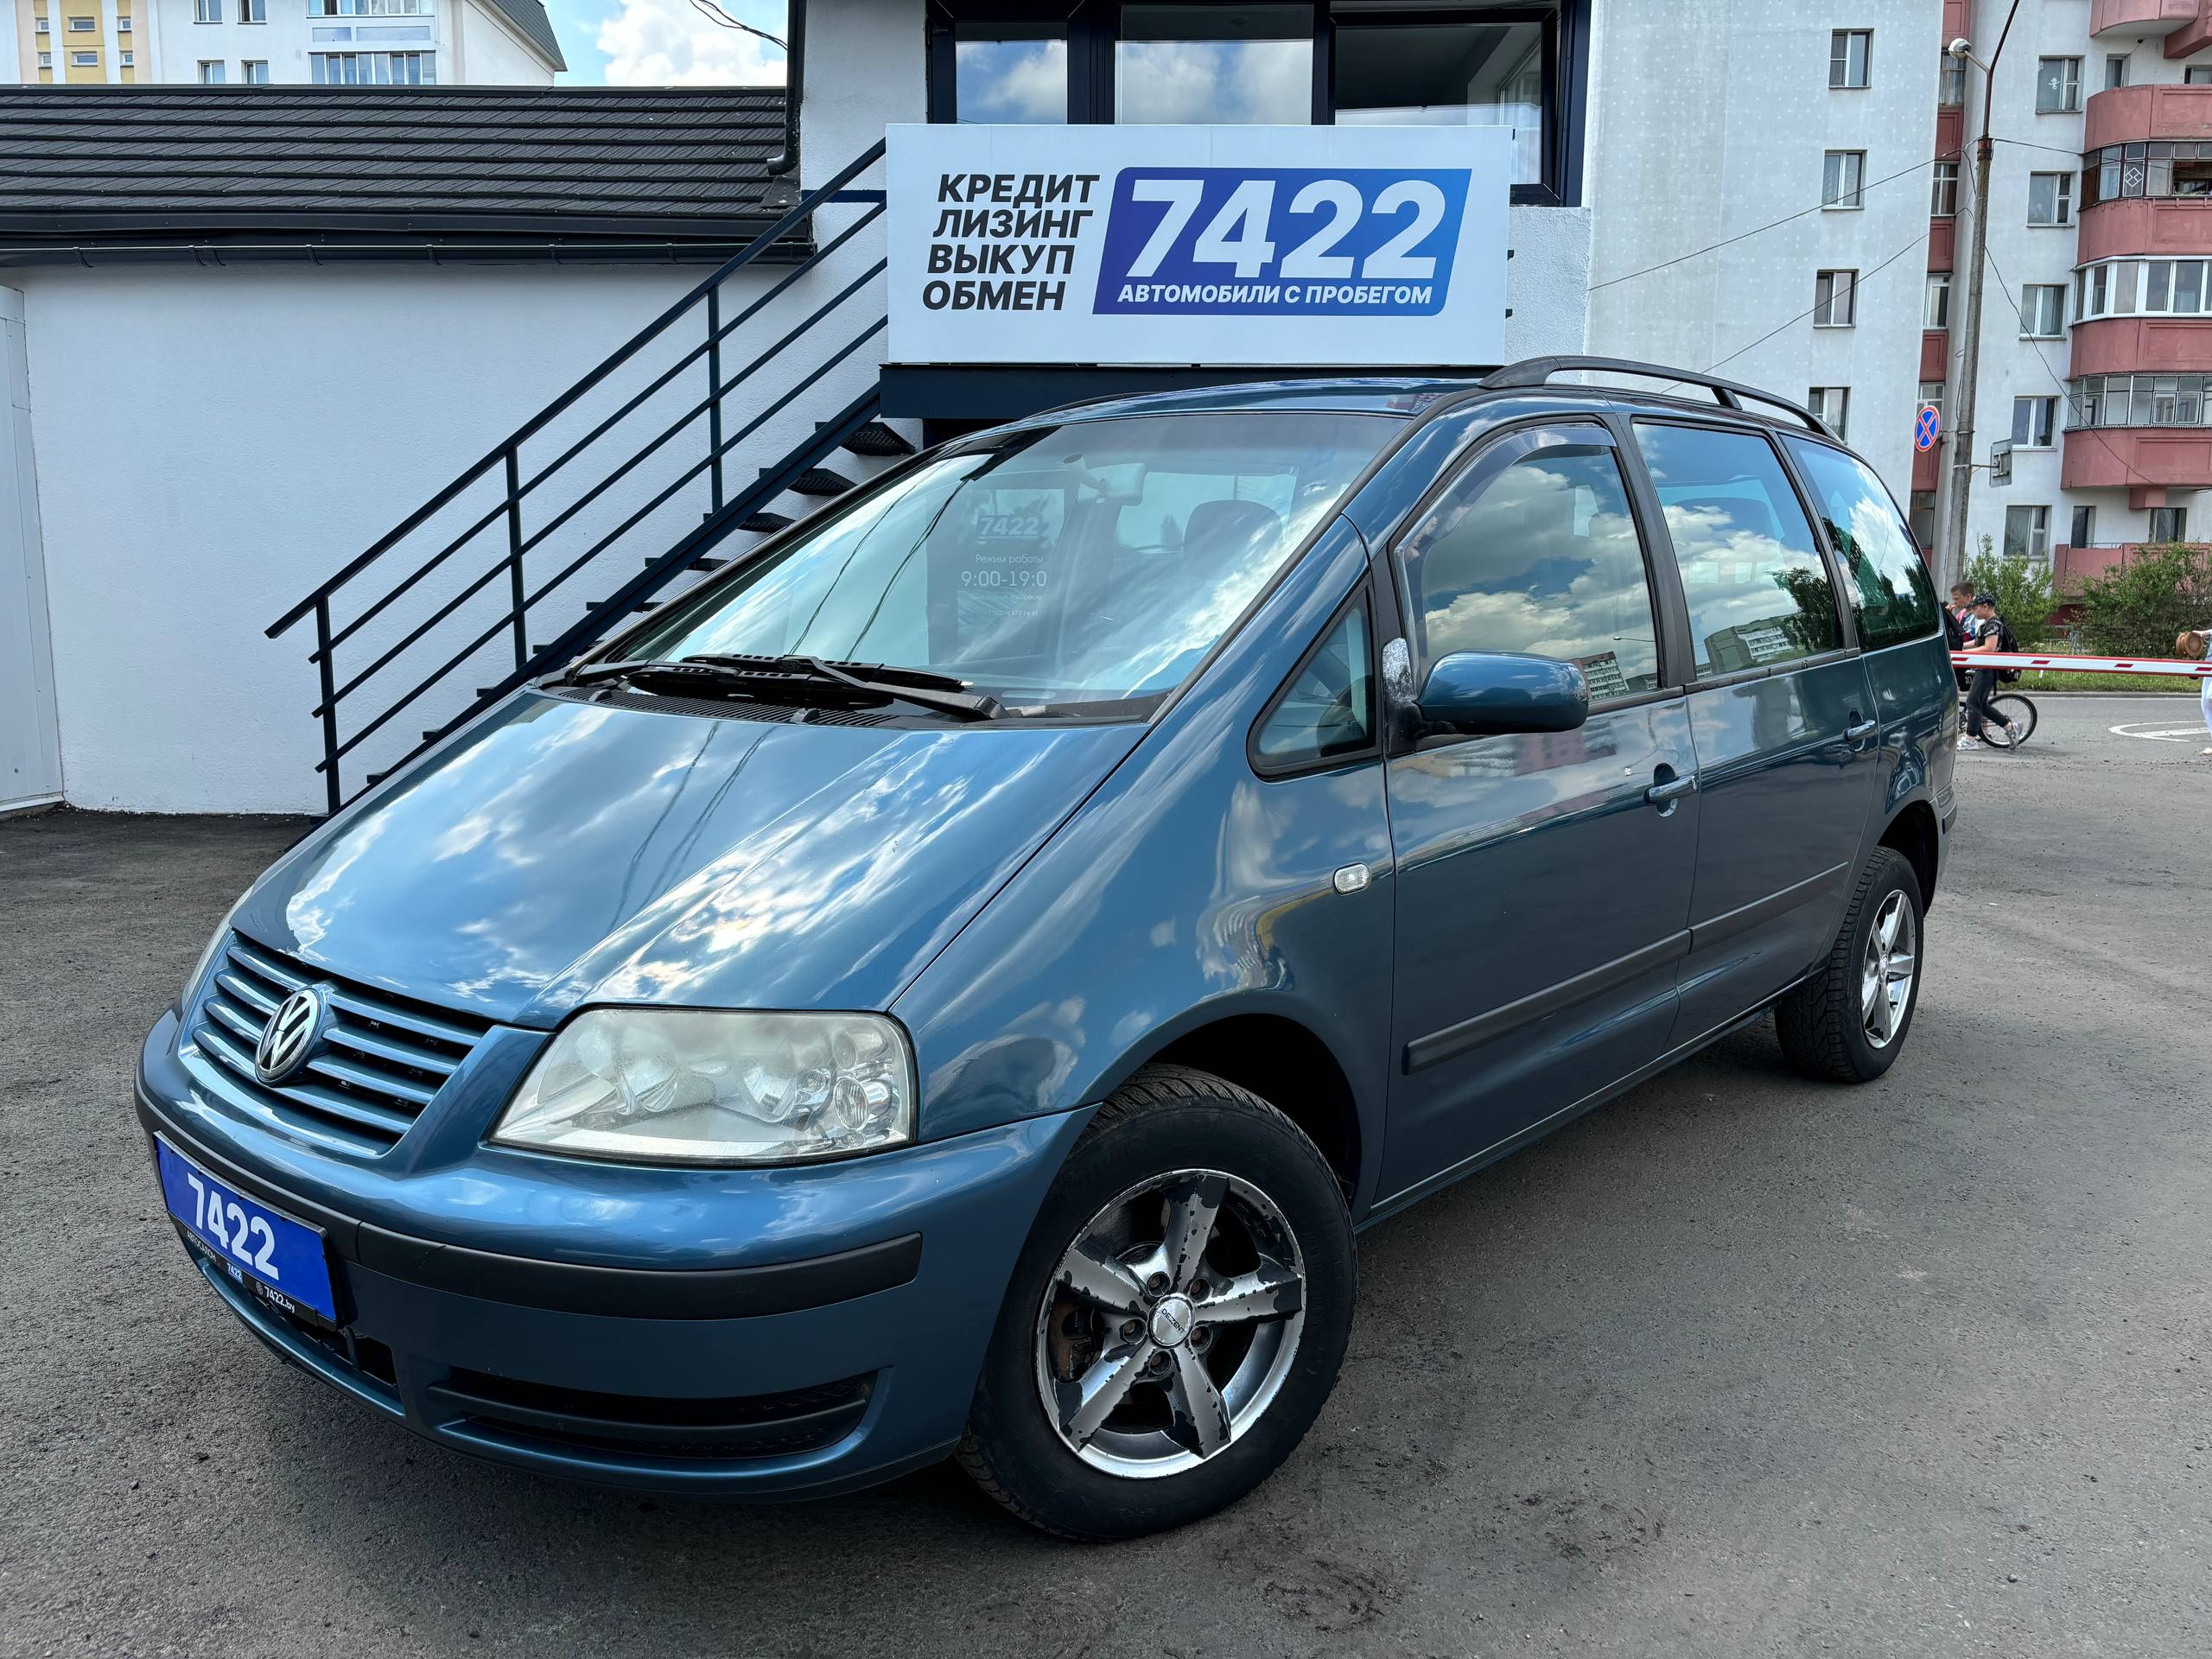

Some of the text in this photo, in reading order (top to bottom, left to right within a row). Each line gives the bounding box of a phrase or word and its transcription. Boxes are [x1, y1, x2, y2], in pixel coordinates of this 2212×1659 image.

[938, 174, 1100, 209] КРЕДИТ
[933, 209, 1094, 238] ЛИЗИНГ
[1126, 179, 1446, 279] 7422
[928, 244, 1076, 275] ВЫКУП
[922, 280, 1066, 311] ОБМЕН
[1117, 283, 1433, 305] АВТОМОБИЛИ С ПРОБЕГОМ
[980, 517, 1039, 535] 7422
[976, 554, 1007, 563] Режим
[187, 1172, 280, 1281] 7422
[264, 1286, 296, 1313] 7422.by
[1161, 1307, 1185, 1333] DEZENT
